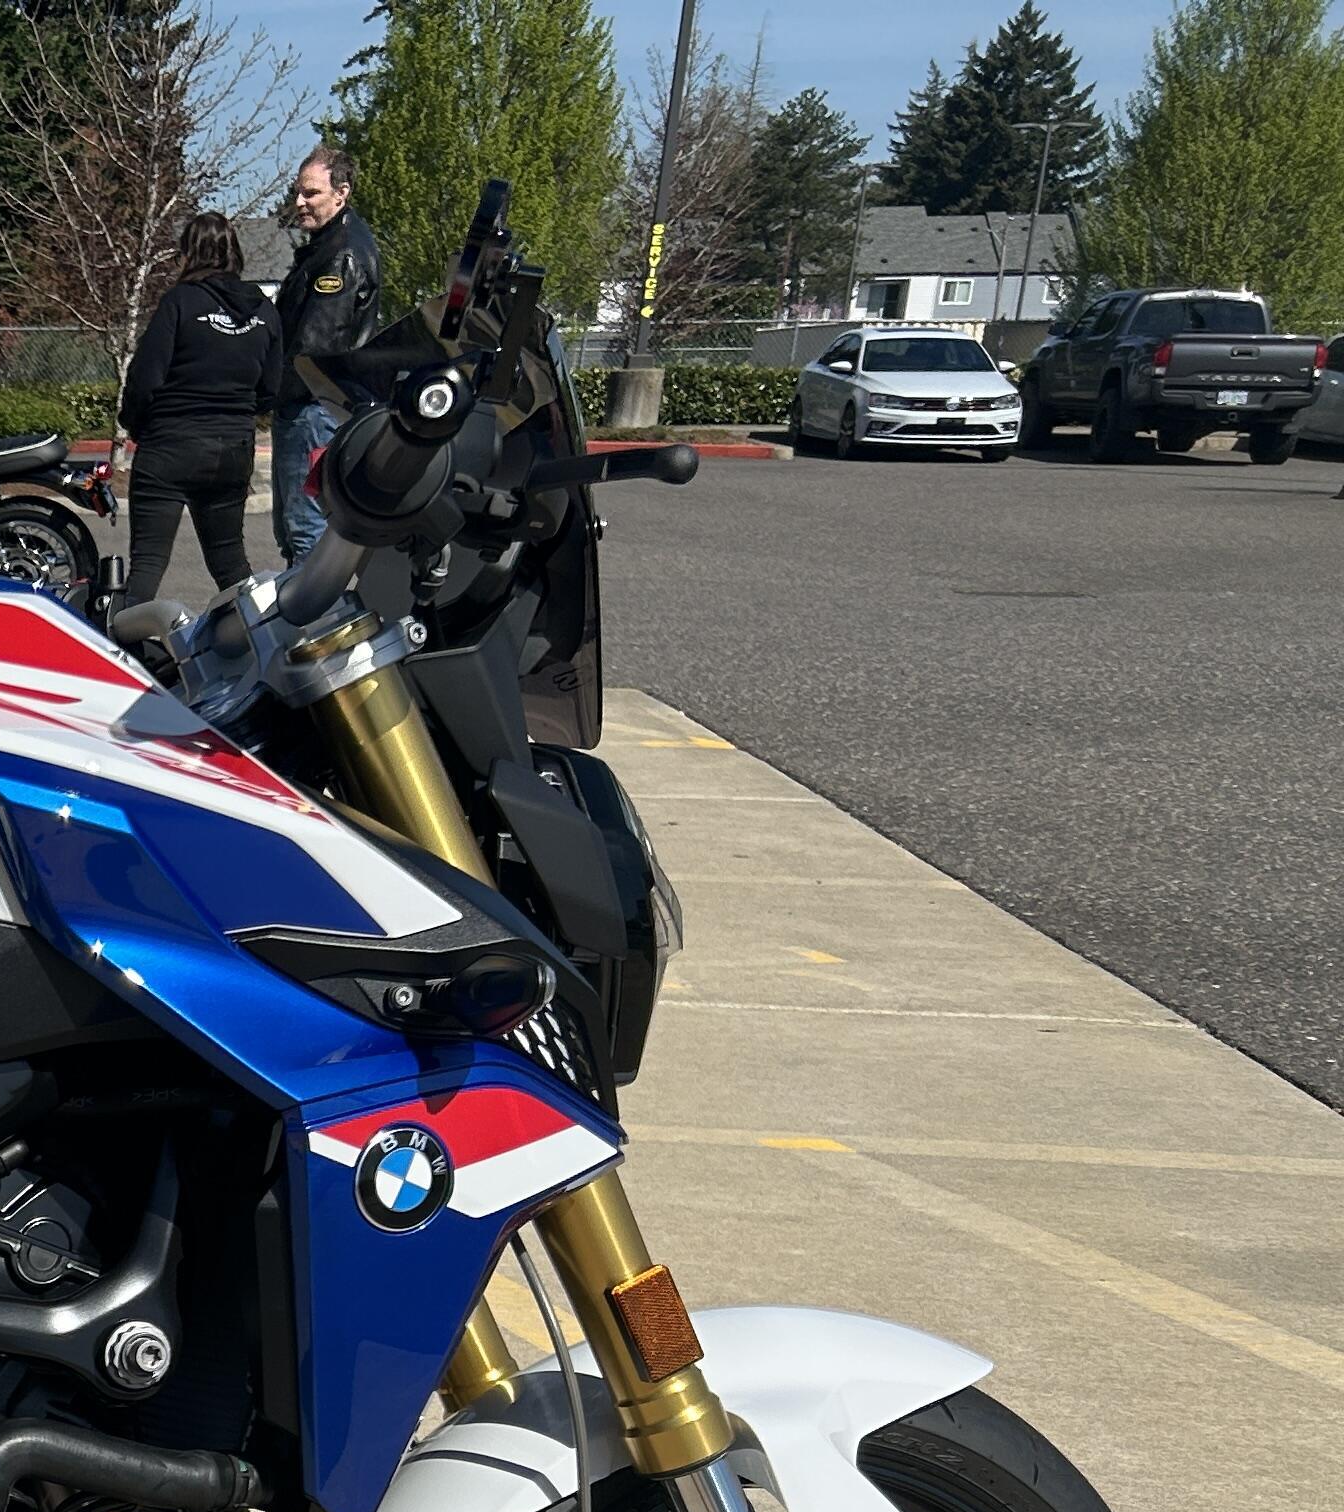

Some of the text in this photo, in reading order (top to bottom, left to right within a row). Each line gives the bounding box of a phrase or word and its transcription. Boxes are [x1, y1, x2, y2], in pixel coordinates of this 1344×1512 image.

[644, 223, 665, 300] SERVICE
[1197, 374, 1282, 383] TACOMA
[379, 1131, 448, 1176] BMW
